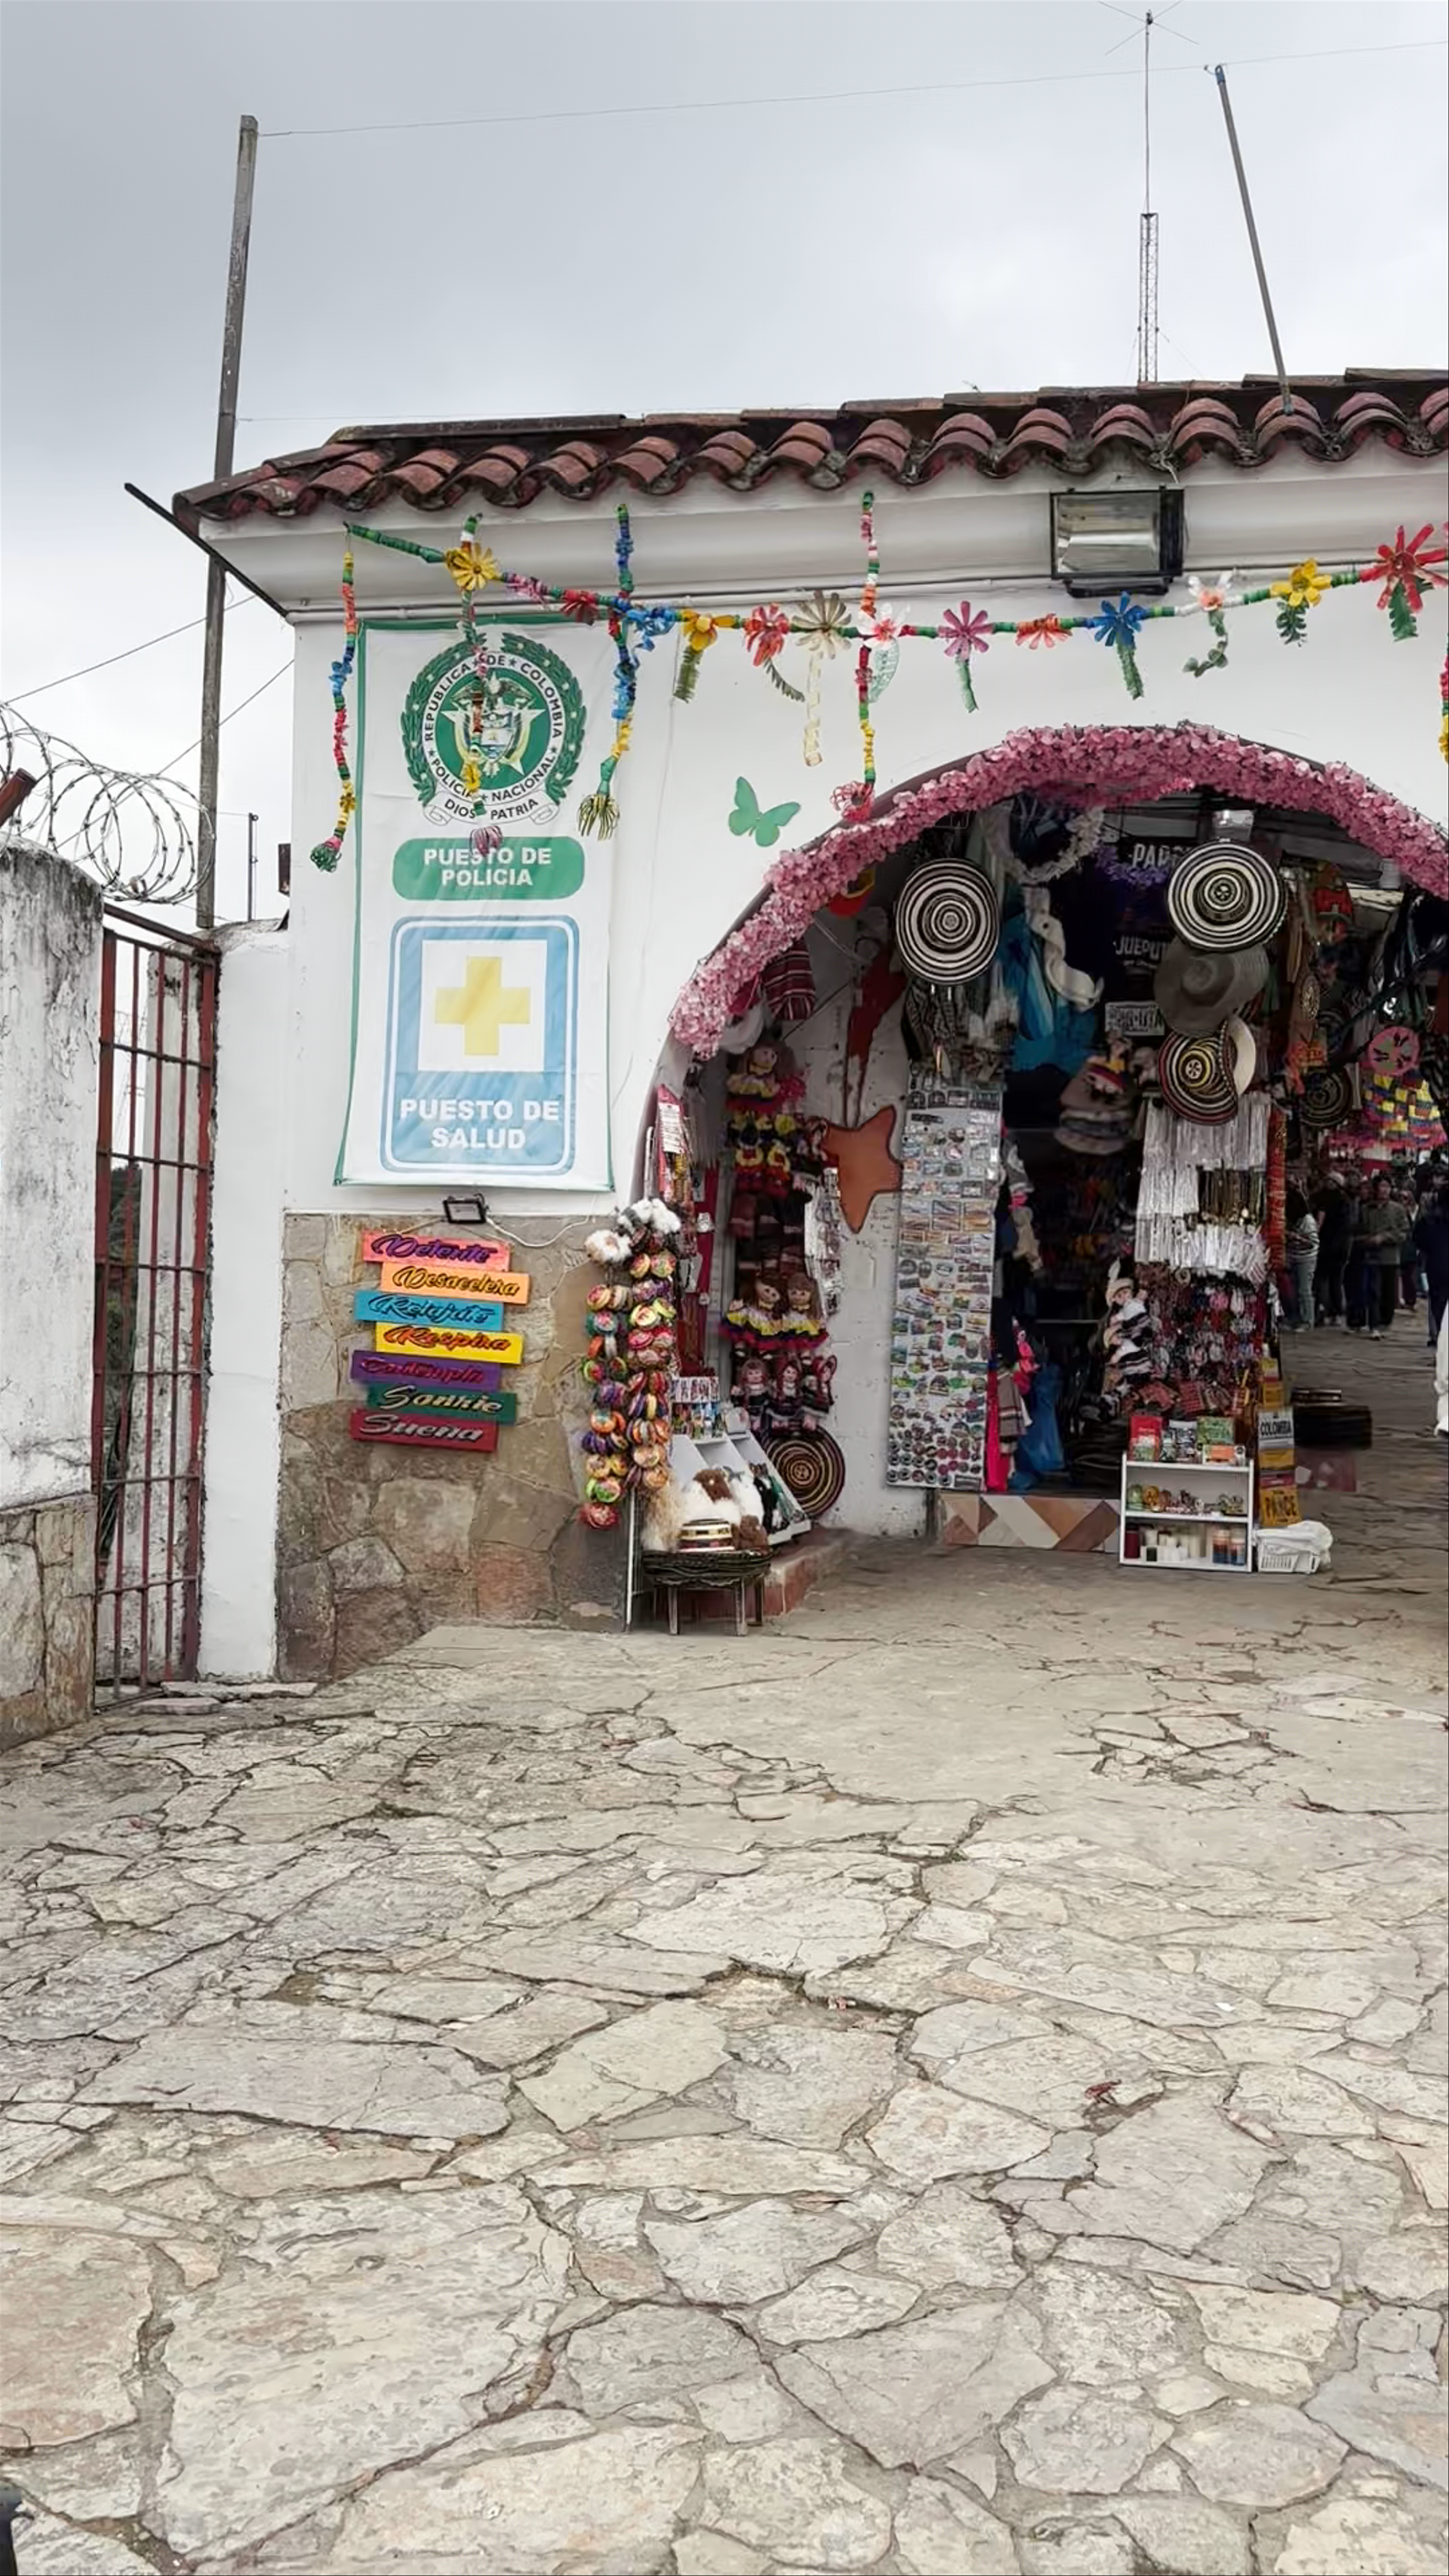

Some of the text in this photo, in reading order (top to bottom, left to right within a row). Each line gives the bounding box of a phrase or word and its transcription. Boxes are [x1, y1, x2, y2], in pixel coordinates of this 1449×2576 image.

[425, 655, 563, 741] REPUBLICA DE COLOMBIA
[492, 757, 556, 802] NACIONAL
[491, 799, 538, 820] PATRIA
[424, 848, 551, 865] PUESTO DE
[441, 869, 533, 886] POLICIA
[400, 1099, 559, 1121] PUESTO DE
[431, 1128, 526, 1149] SALUD
